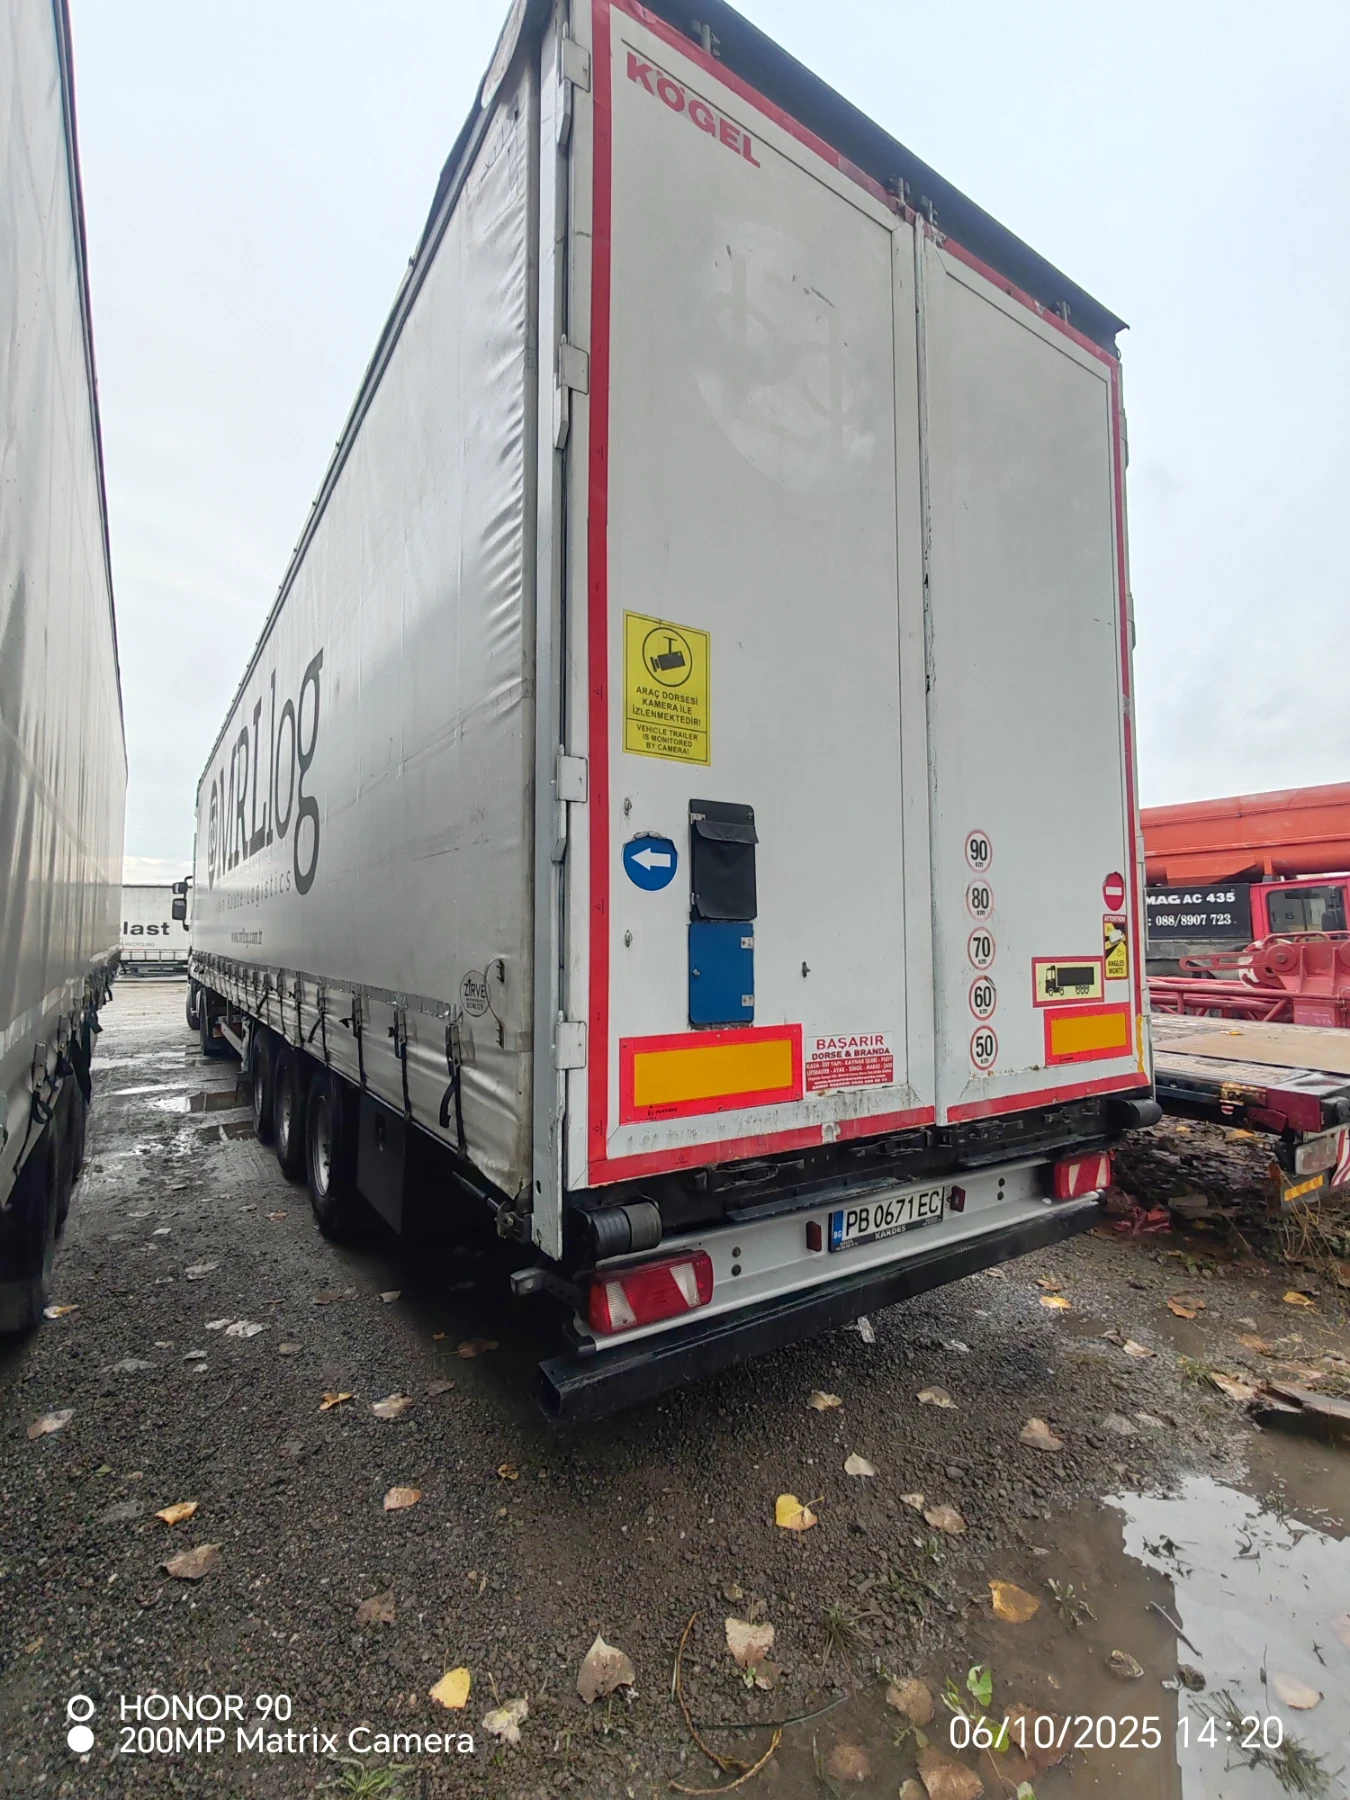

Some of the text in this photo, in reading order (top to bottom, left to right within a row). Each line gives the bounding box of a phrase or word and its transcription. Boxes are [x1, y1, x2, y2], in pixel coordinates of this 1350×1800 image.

[627, 51, 760, 168] KÖGEL
[636, 686, 698, 706] ARAÇ DORSESİ
[642, 698, 692, 715] KAMERA İLE
[637, 724, 698, 741] VEHICLE TRAILER
[652, 734, 692, 748] MONITORED
[658, 744, 689, 755] CAMERA!
[970, 839, 987, 861] 90
[247, 870, 290, 908] Logistics
[972, 888, 989, 909] 80
[1146, 892, 1235, 905] MAG AC 435
[120, 922, 170, 935] last
[1156, 914, 1231, 927] 088/8907 723
[973, 936, 990, 958] 70
[974, 986, 991, 1008] 60
[817, 1035, 884, 1050] BAŞARIR
[976, 1035, 993, 1058] 50
[812, 1051, 842, 1060] DORSE
[854, 1047, 890, 1056] BRANDA
[846, 1208, 870, 1237] PB
[834, 1230, 842, 1239] BG
